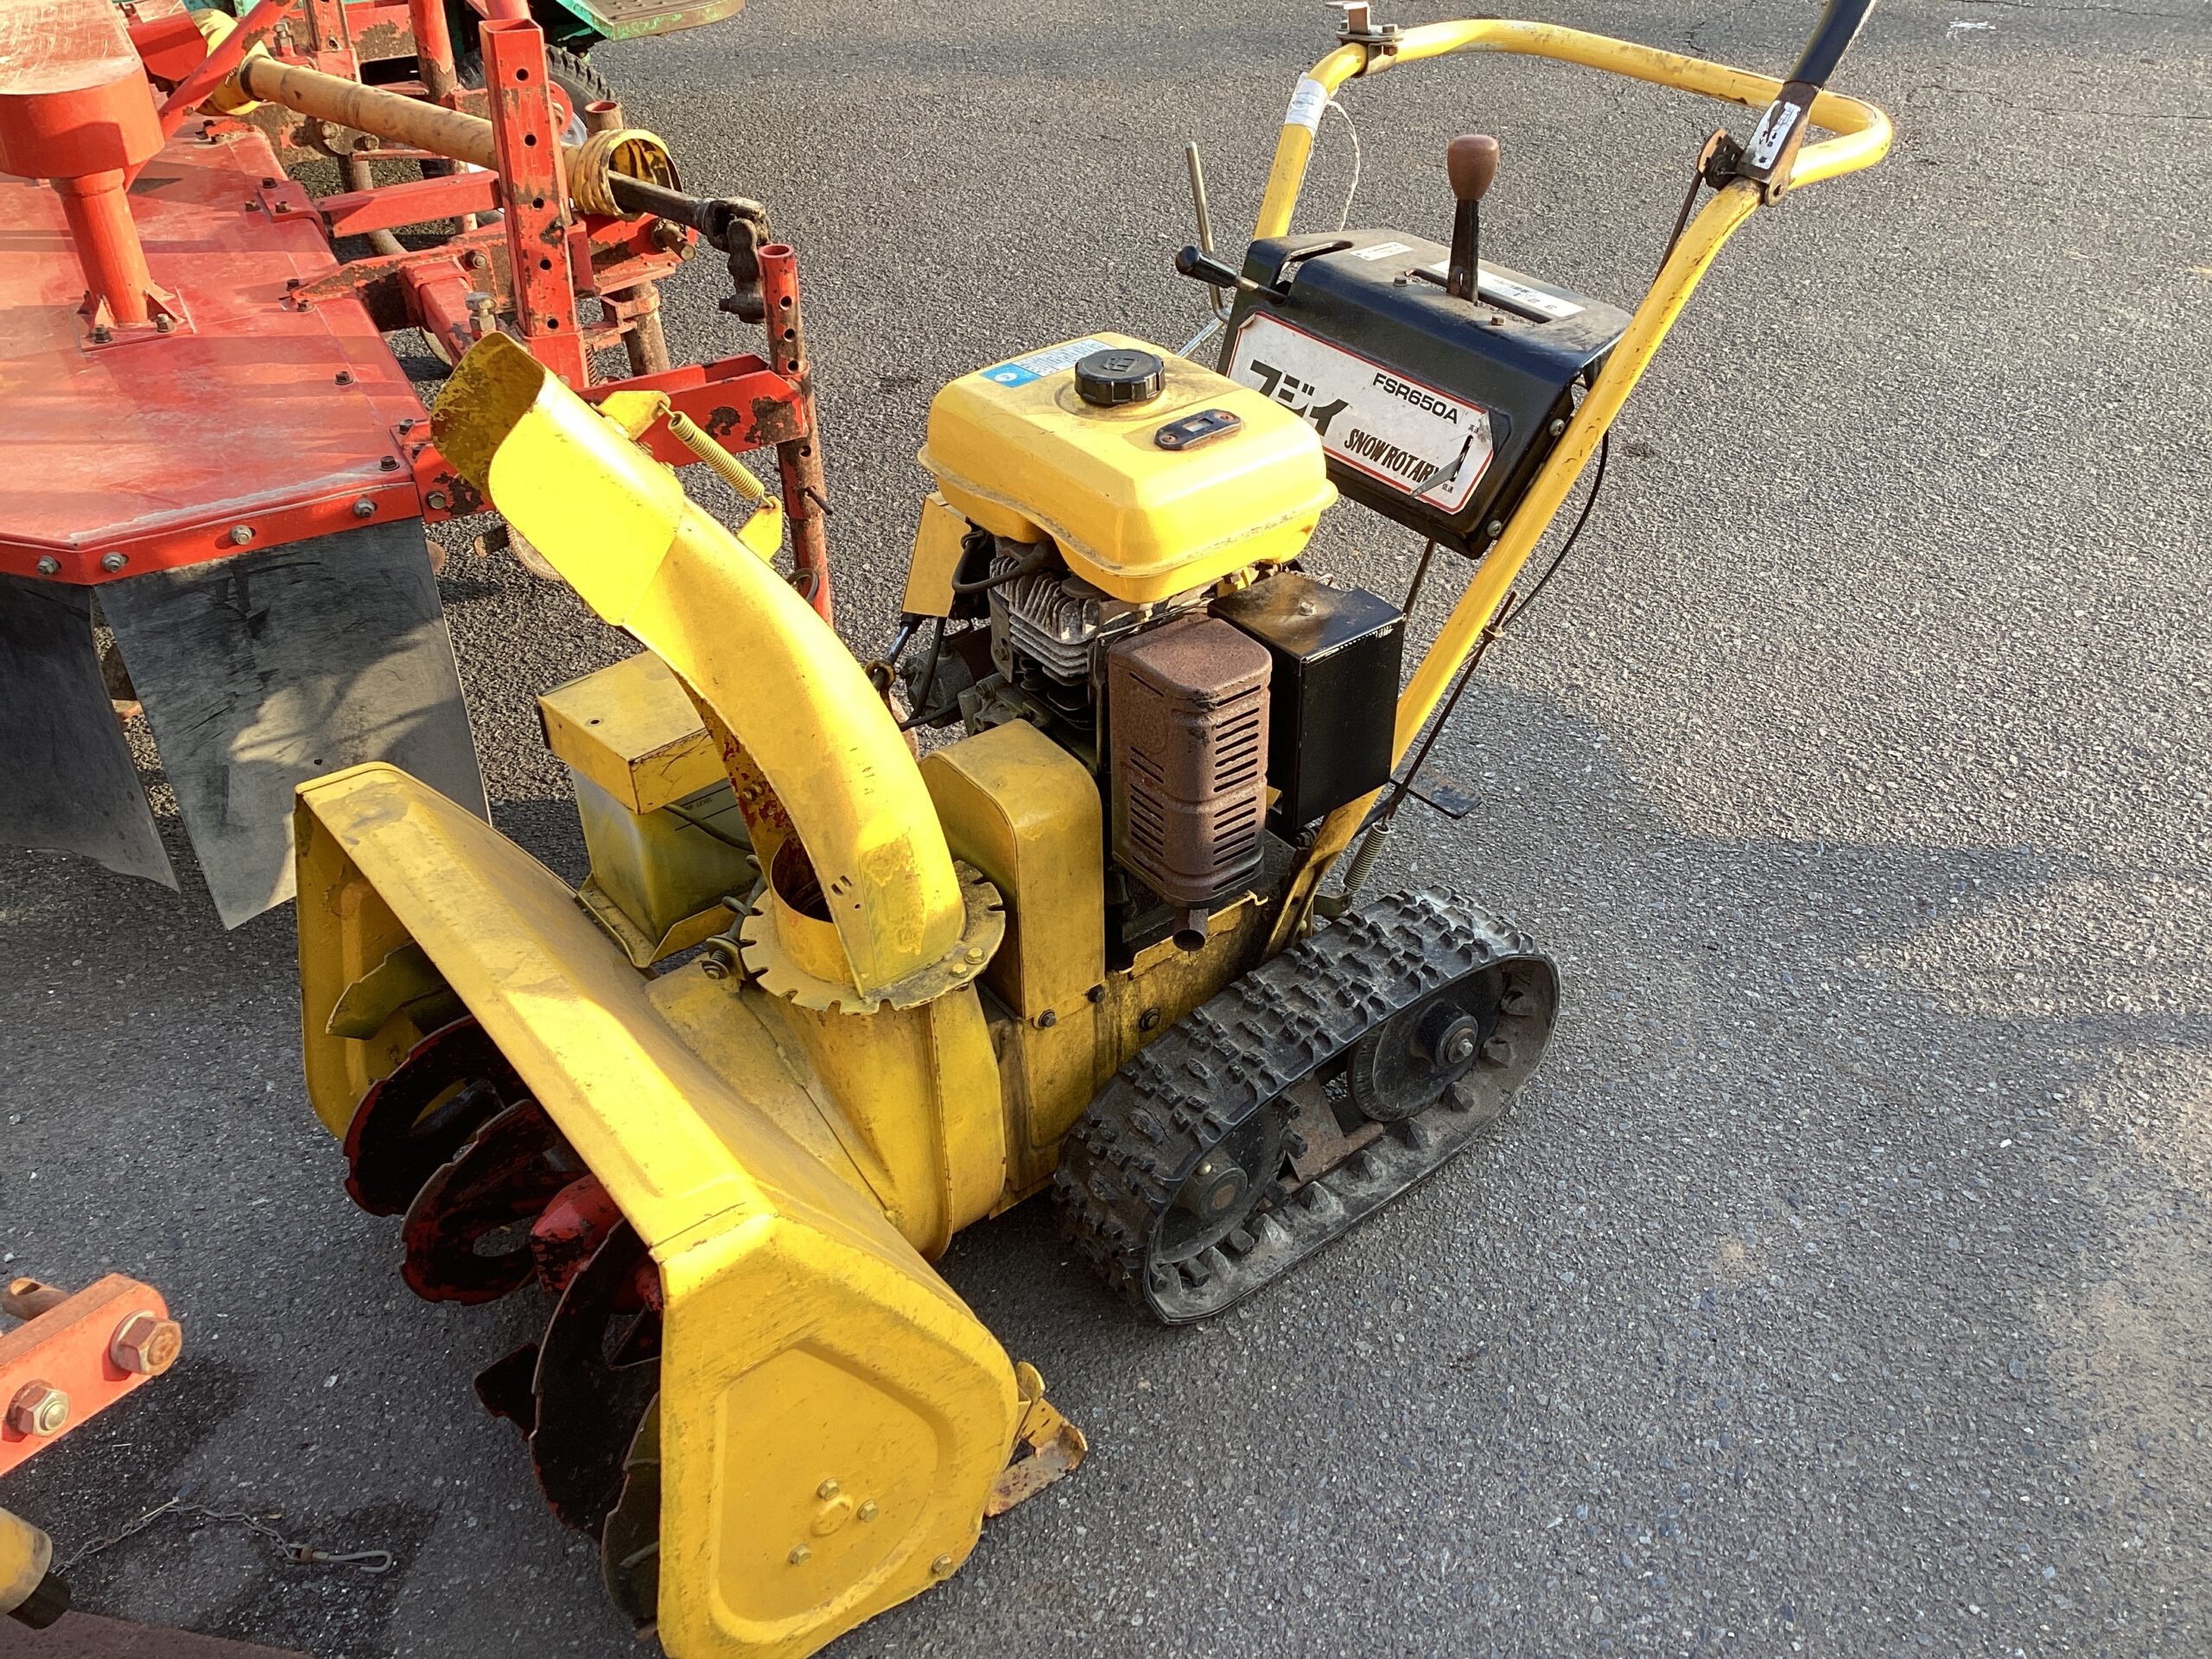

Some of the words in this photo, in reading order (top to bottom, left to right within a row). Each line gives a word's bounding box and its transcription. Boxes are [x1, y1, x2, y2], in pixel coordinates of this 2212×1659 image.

[1249, 359, 1350, 437] フジイ
[1372, 372, 1458, 424] FSR650A
[1381, 444, 1440, 483] ROTAR
